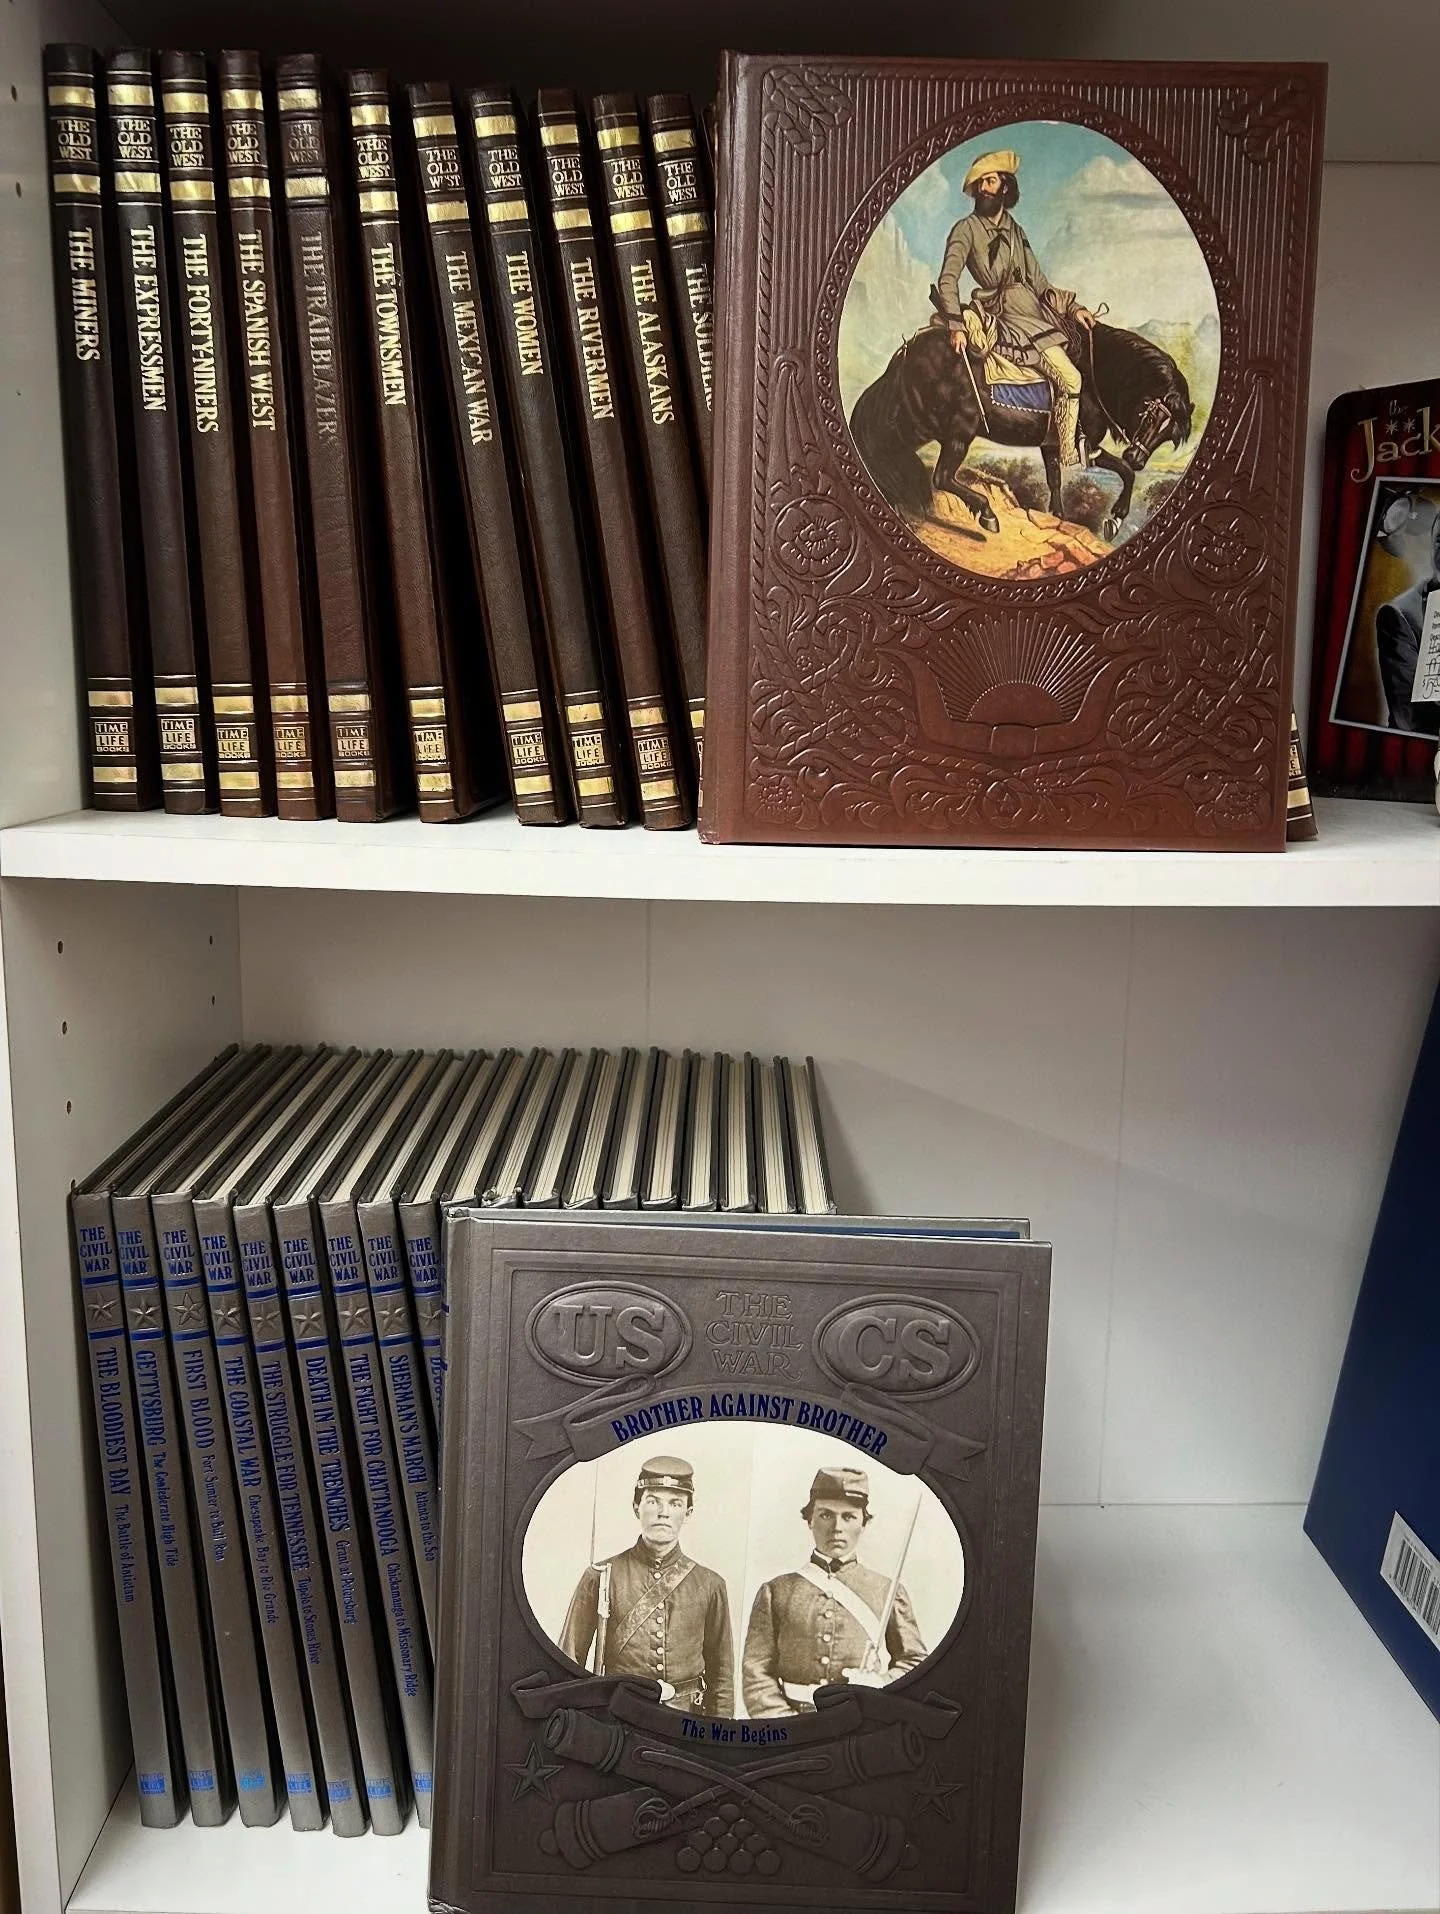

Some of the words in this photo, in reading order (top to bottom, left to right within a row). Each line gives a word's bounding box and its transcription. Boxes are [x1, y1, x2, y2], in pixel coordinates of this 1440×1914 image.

[58, 120, 90, 133] THE
[118, 119, 150, 132] THE
[170, 126, 202, 140] THE
[226, 123, 257, 137] THE
[58, 133, 92, 146] OLD
[117, 132, 152, 145] OLD
[170, 140, 203, 153] OLD
[227, 137, 258, 150] OLD
[357, 139, 388, 152] THE
[59, 146, 92, 160] WEST
[120, 146, 153, 159] WEST
[172, 153, 205, 167] WEST
[228, 150, 260, 164] WEST
[358, 152, 390, 165] OLD
[426, 149, 456, 162] THE
[488, 149, 518, 162] THE
[360, 165, 391, 178] WEST
[427, 162, 458, 175] OLD
[489, 162, 520, 175] OLD
[551, 158, 581, 171] THE
[611, 159, 641, 172] THE
[665, 162, 694, 176] THE
[491, 174, 522, 187] WEST
[552, 170, 583, 183] OLD
[613, 172, 643, 185] OLD
[666, 175, 697, 189] OLD
[554, 183, 585, 196] WEST
[614, 185, 645, 198] WEST
[668, 188, 698, 202] WEST
[68, 227, 94, 272] THE
[130, 225, 157, 269] THE
[238, 229, 264, 275] THE
[301, 232, 325, 277] THE
[182, 234, 209, 279] THE
[371, 243, 395, 288] THE
[445, 250, 472, 294] THE
[506, 250, 532, 294] THE
[570, 257, 597, 302] THE
[630, 260, 657, 306] THE
[685, 263, 713, 308] THE
[72, 278, 101, 362] MINERS
[240, 279, 269, 370] SPANISH
[134, 274, 168, 412] EXPRESSMEN
[512, 297, 544, 376] WOMEN
[375, 288, 407, 407] TOWNSMEN
[452, 300, 485, 400] MEXICAN
[187, 285, 220, 434] FORTY-NINERS
[577, 307, 614, 421] RIVERMEN
[636, 311, 675, 425] ALASKANS
[248, 375, 276, 431] WEST
[468, 400, 494, 446] WAR
[96, 722, 127, 734] TIME
[162, 720, 195, 731] TIME
[218, 728, 248, 740] TIME
[275, 728, 304, 739] TIME
[338, 727, 368, 738] TIME
[415, 731, 444, 743] TIME
[513, 733, 543, 746] TIME
[572, 735, 602, 748] TIME
[639, 738, 670, 752] TIME
[80, 1226, 106, 1242] THE
[118, 1230, 142, 1244] THE
[163, 1230, 188, 1244] THE
[202, 1235, 228, 1250] THE
[328, 1235, 353, 1250] THE
[368, 1235, 393, 1250] THE
[80, 1242, 113, 1258] CIVIL
[118, 1245, 149, 1260] CIVIL
[164, 1244, 195, 1260] CIVIL
[241, 1240, 267, 1256] THE
[283, 1238, 309, 1253] THE
[407, 1237, 433, 1252] THE
[85, 1257, 111, 1273] WAR
[202, 1250, 233, 1266] CIVIL
[242, 1256, 273, 1272] CIVIL
[284, 1253, 316, 1269] CIVIL
[330, 1251, 361, 1267] CIVIL
[369, 1250, 400, 1267] CIVIL
[409, 1252, 440, 1268] CIVIL
[122, 1260, 148, 1275] WAR
[168, 1260, 193, 1275] WAR
[207, 1266, 233, 1281] WAR
[289, 1268, 315, 1284] WAR
[334, 1267, 359, 1282] WAR
[374, 1267, 399, 1282] WAR
[412, 1268, 438, 1283] WAR
[246, 1271, 273, 1287] WAR
[716, 1290, 794, 1318] THE
[552, 1303, 665, 1370] US
[705, 1320, 804, 1350] CIVIL
[838, 1317, 950, 1383] CS
[96, 1347, 119, 1379] THE
[183, 1349, 208, 1391] FIRST
[224, 1356, 247, 1387] THE
[349, 1353, 372, 1383] THE
[713, 1350, 802, 1382] WAR
[261, 1360, 284, 1390] THE
[305, 1356, 332, 1404] DEATH
[135, 1350, 166, 1446] GETTYSBURG
[389, 1354, 420, 1434] SHERMAN'S
[354, 1383, 379, 1425] FIGHT
[100, 1381, 128, 1463] BLOODIEST
[190, 1398, 215, 1449] BLOOD
[228, 1391, 257, 1455] COASTAL
[313, 1407, 335, 1423] IN
[265, 1391, 295, 1463] STRUGGLE
[610, 1396, 704, 1445] BROTHER
[709, 1394, 796, 1420] AGAINST
[798, 1401, 890, 1456] BROTHER
[316, 1425, 340, 1456] THE
[361, 1428, 383, 1457] FOR
[152, 1451, 167, 1469] The
[201, 1454, 216, 1474] Fort
[402, 1435, 428, 1485] MARCH
[240, 1456, 262, 1487] WAR
[276, 1463, 298, 1492] FOR
[109, 1468, 131, 1495] DAY
[153, 1471, 170, 1521] Confederate
[204, 1475, 219, 1508] Sumter
[320, 1458, 351, 1533] TRENCHES
[115, 1504, 129, 1522] The
[366, 1459, 400, 1557] CHATTANOOGA
[415, 1490, 428, 1523] Atlanta
[248, 1494, 267, 1543] Chesapeake
[115, 1523, 132, 1551] Battle
[161, 1523, 176, 1545] High
[210, 1520, 224, 1541] Bull
[282, 1493, 310, 1571] TENNESSEE
[166, 1547, 179, 1567] Tide
[213, 1541, 226, 1561] Run
[256, 1546, 269, 1562] Bay
[335, 1540, 350, 1565] Grant
[425, 1545, 438, 1562] Sea
[261, 1576, 275, 1590] Rio
[386, 1562, 405, 1616] Chickamauga
[263, 1593, 279, 1624] Grande
[341, 1577, 358, 1624] Petersburg
[398, 1627, 412, 1673] Missionary
[404, 1673, 417, 1697] Ridge
[681, 1718, 706, 1739] The
[711, 1722, 737, 1742] War
[741, 1724, 788, 1745] Begins
